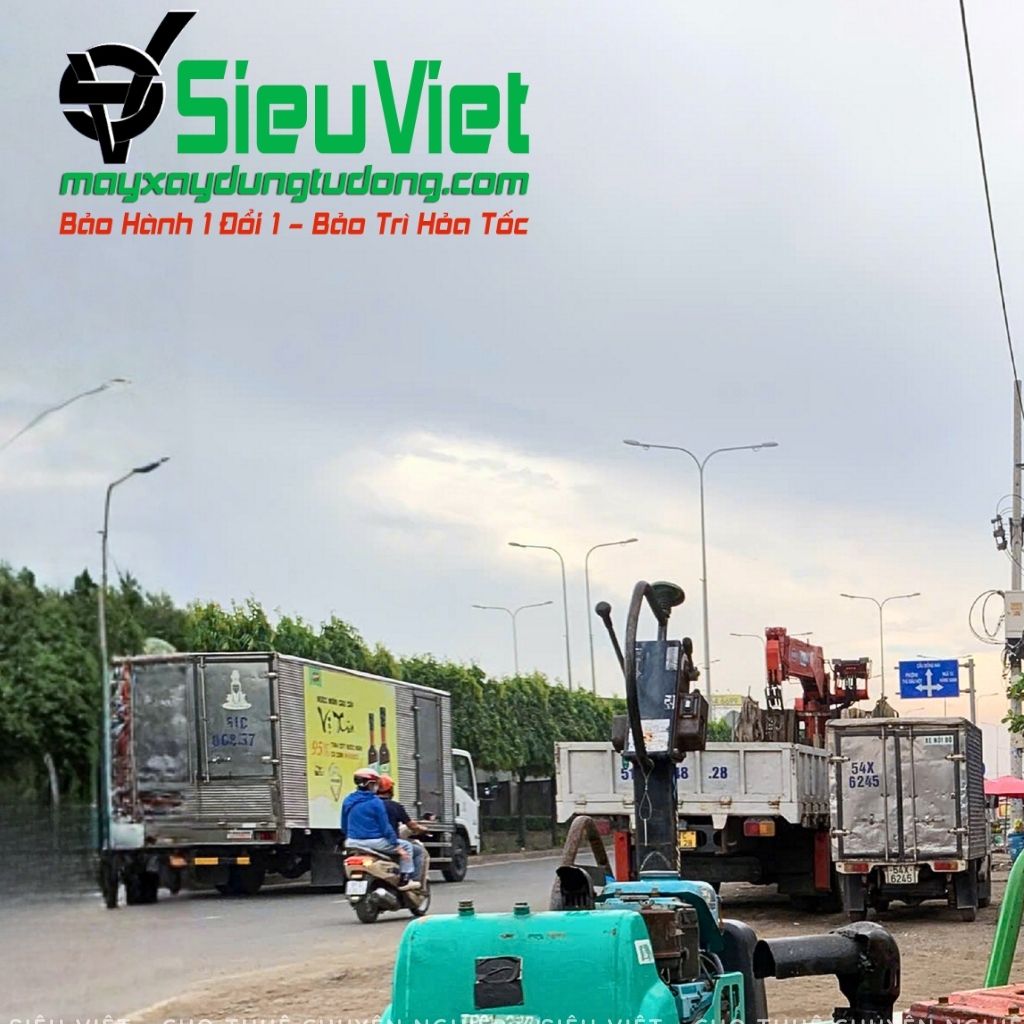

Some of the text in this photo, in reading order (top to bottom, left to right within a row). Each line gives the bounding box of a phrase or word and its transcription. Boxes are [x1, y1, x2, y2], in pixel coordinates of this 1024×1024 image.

[851, 761, 874, 774] 54X
[849, 775, 880, 789] 6245
[891, 873, 912, 883] 6245
